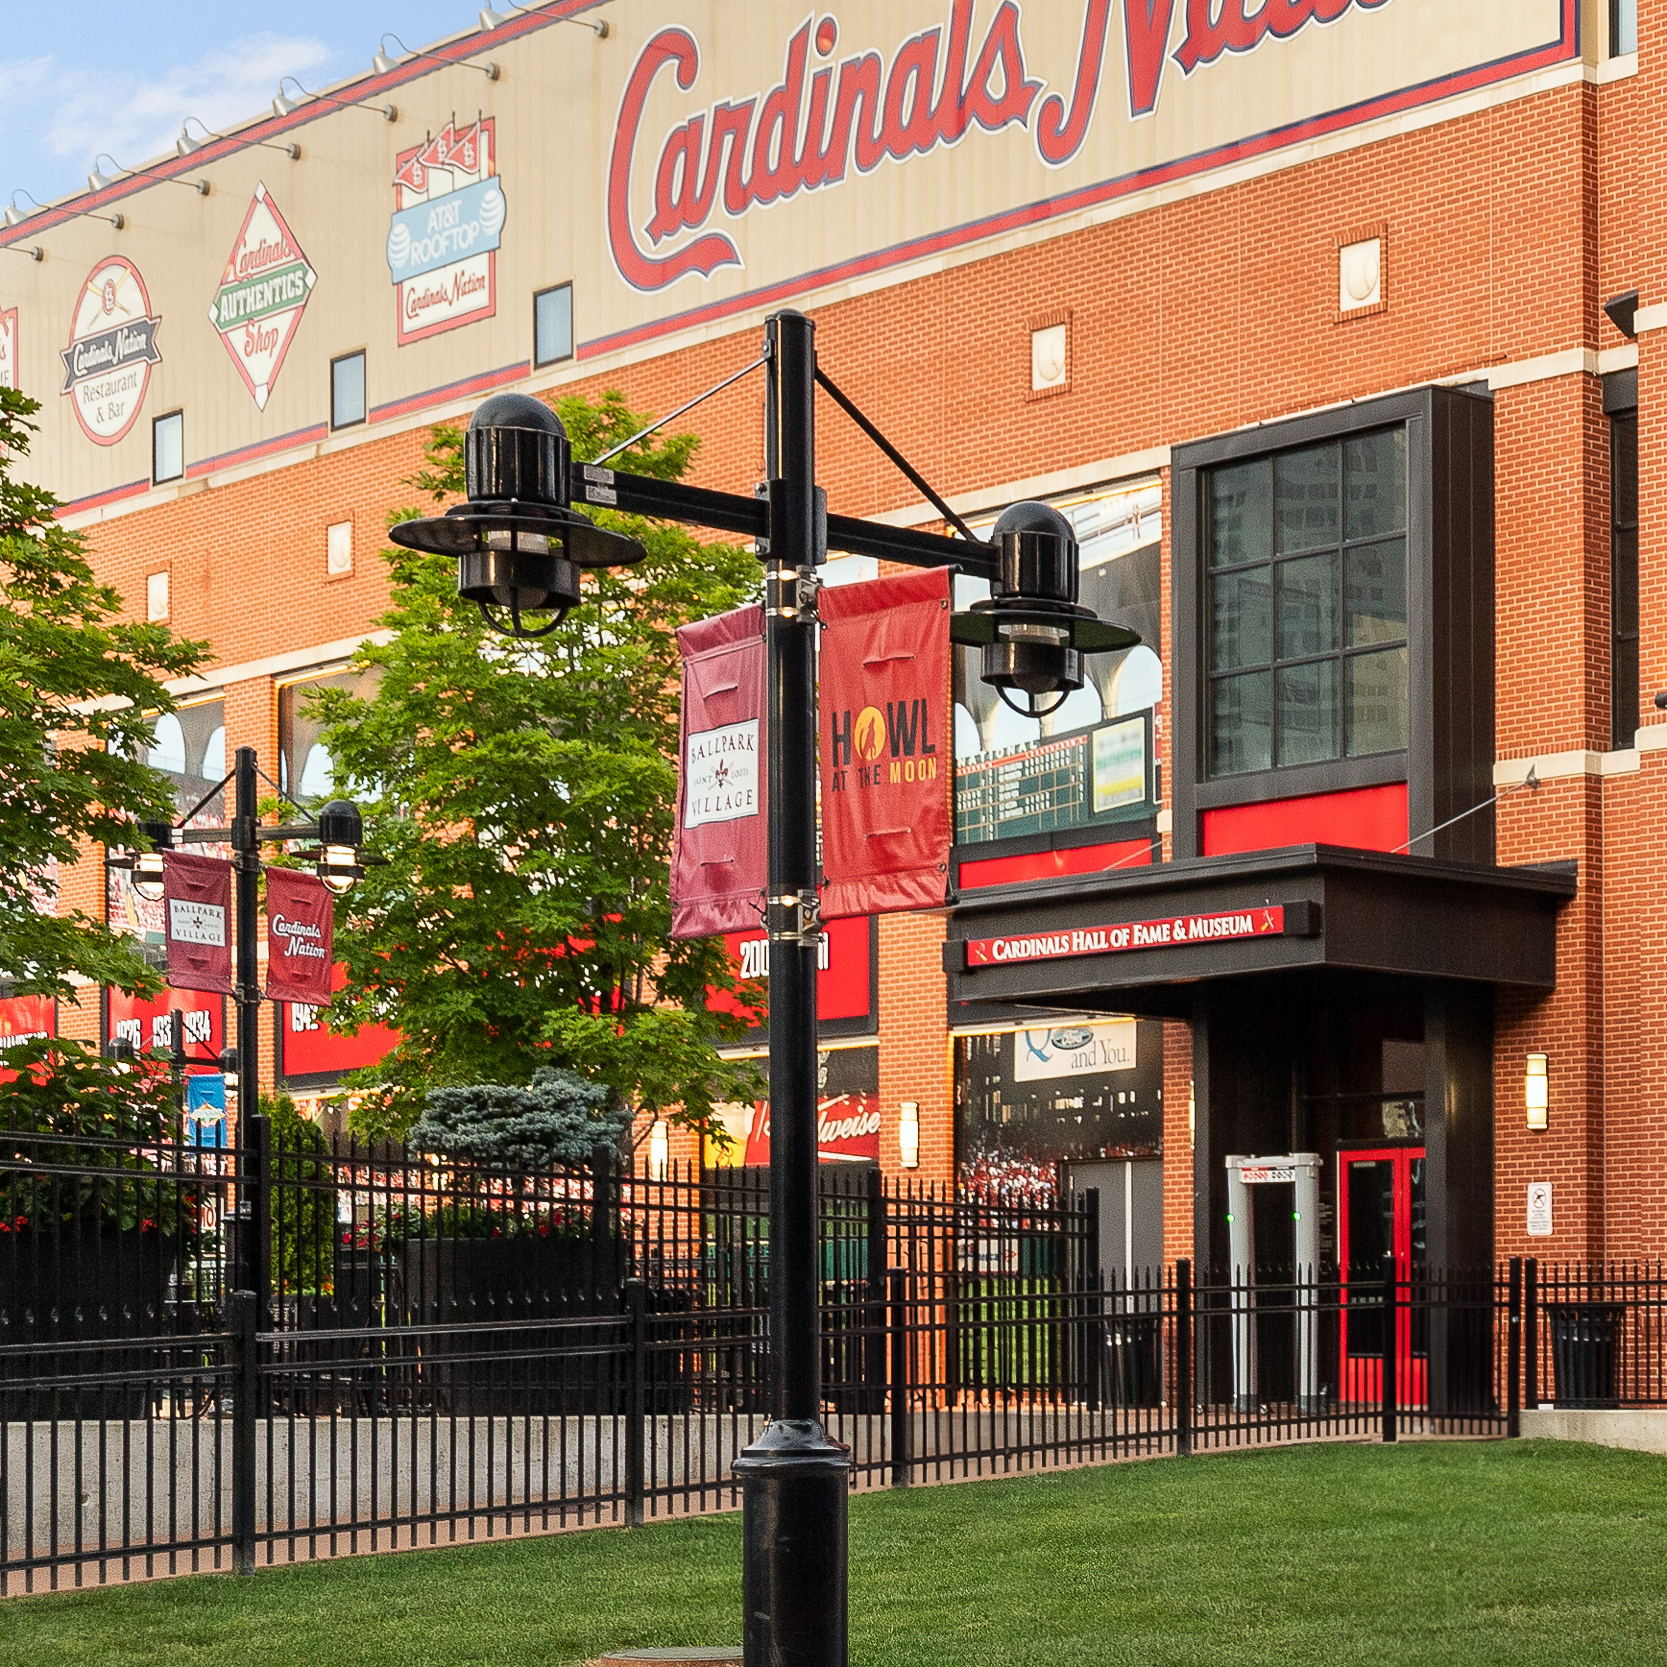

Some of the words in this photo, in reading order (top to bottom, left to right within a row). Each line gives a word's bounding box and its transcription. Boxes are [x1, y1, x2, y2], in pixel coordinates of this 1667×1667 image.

[427, 199, 462, 229] AT&T
[234, 236, 293, 281] Cardinals
[410, 222, 481, 266] ROOFTOP
[221, 271, 304, 323] AUTHENTICS
[406, 285, 449, 320] Cardinals
[447, 270, 486, 306] Nation
[73, 343, 113, 377] Cardinals
[112, 328, 147, 365] Nation
[245, 319, 279, 357] Shop
[83, 372, 138, 404] Restaurant
[96, 408, 105, 424] &
[108, 403, 125, 420] Bar
[691, 733, 755, 763] BALLPARK
[831, 699, 936, 768] HOWL
[831, 770, 847, 793] AT
[857, 763, 881, 789] THE
[889, 757, 937, 785] MOON
[691, 789, 753, 817] VILLAGE
[173, 904, 224, 920] BALLPARK
[272, 913, 321, 938] Cardinals
[175, 928, 222, 942] VILLAGE
[284, 936, 326, 959] Nation
[992, 934, 1069, 961] CARDINALS
[1072, 930, 1108, 952] HALL
[1111, 929, 1130, 948] OF
[1133, 924, 1171, 946] FAME
[1173, 920, 1187, 940] &
[1189, 914, 1253, 939] MUSEUM
[1071, 1045, 1097, 1069] and
[1099, 1038, 1130, 1066] You.
